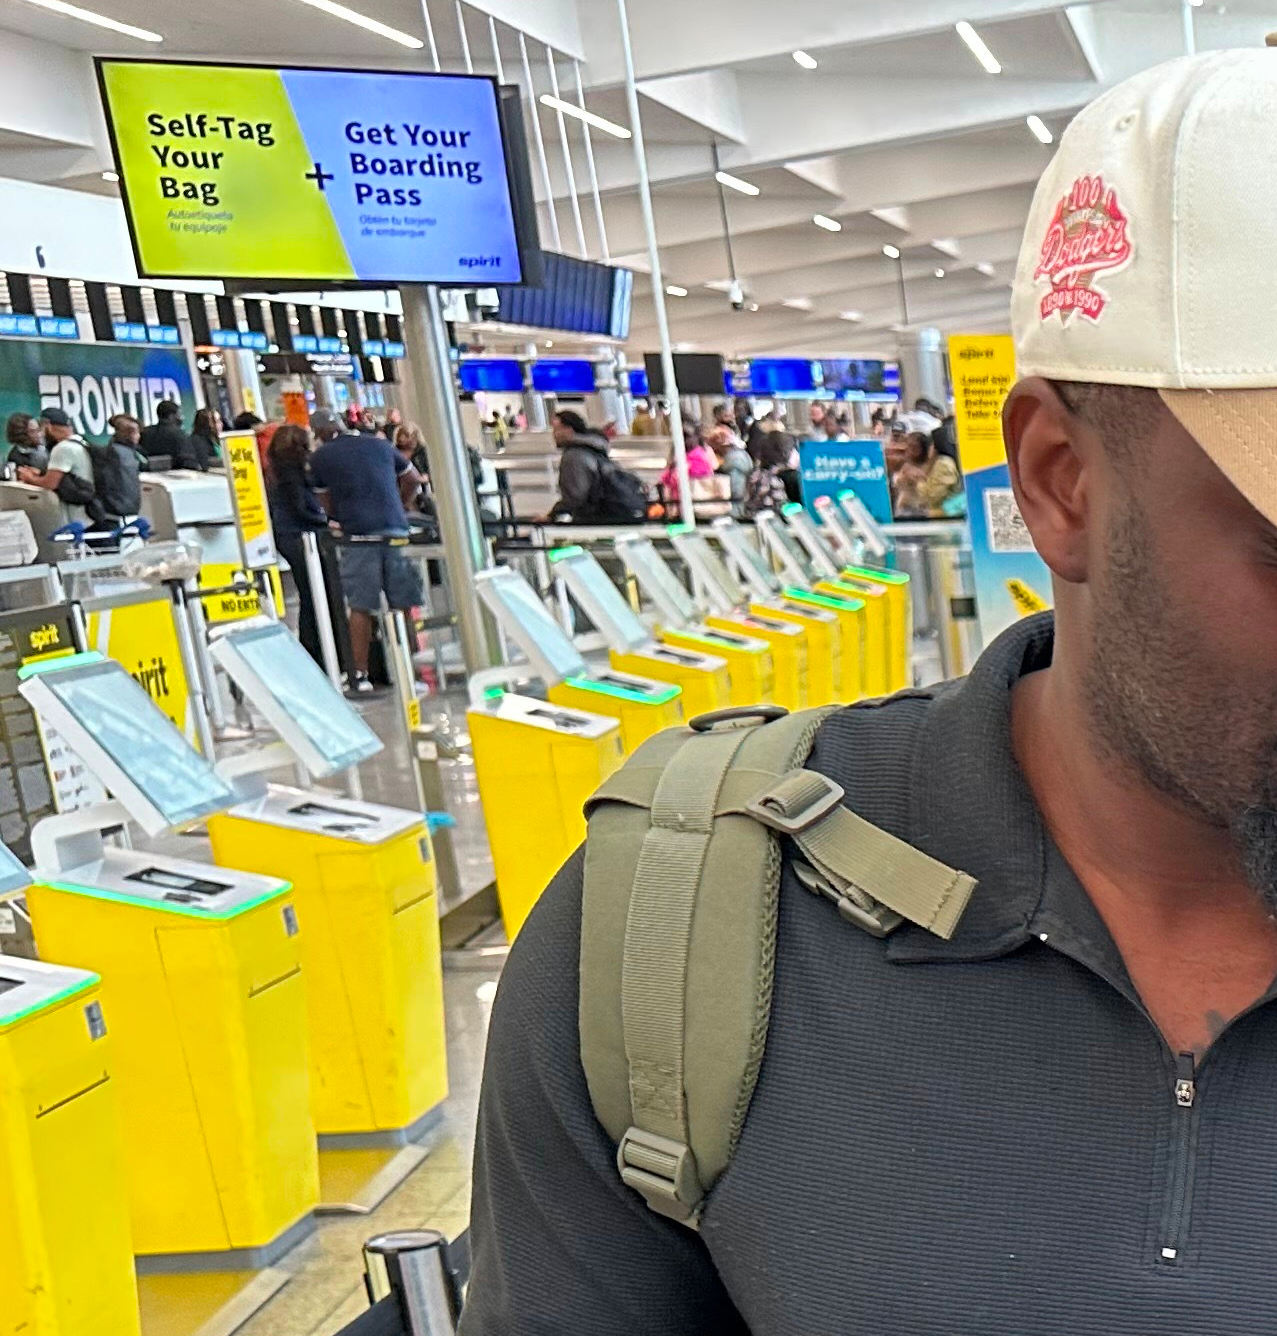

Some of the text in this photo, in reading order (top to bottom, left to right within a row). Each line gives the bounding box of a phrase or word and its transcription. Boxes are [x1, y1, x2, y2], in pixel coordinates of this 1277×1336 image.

[147, 113, 275, 147] Self-Tag
[345, 122, 471, 147] Get Your
[151, 146, 224, 170] Your
[350, 152, 482, 184] Boarding
[159, 176, 219, 206] Bag
[355, 183, 422, 206] Pass
[458, 255, 501, 268] spirit
[1034, 217, 1131, 289] Dodgers
[131, 656, 170, 698] irit
